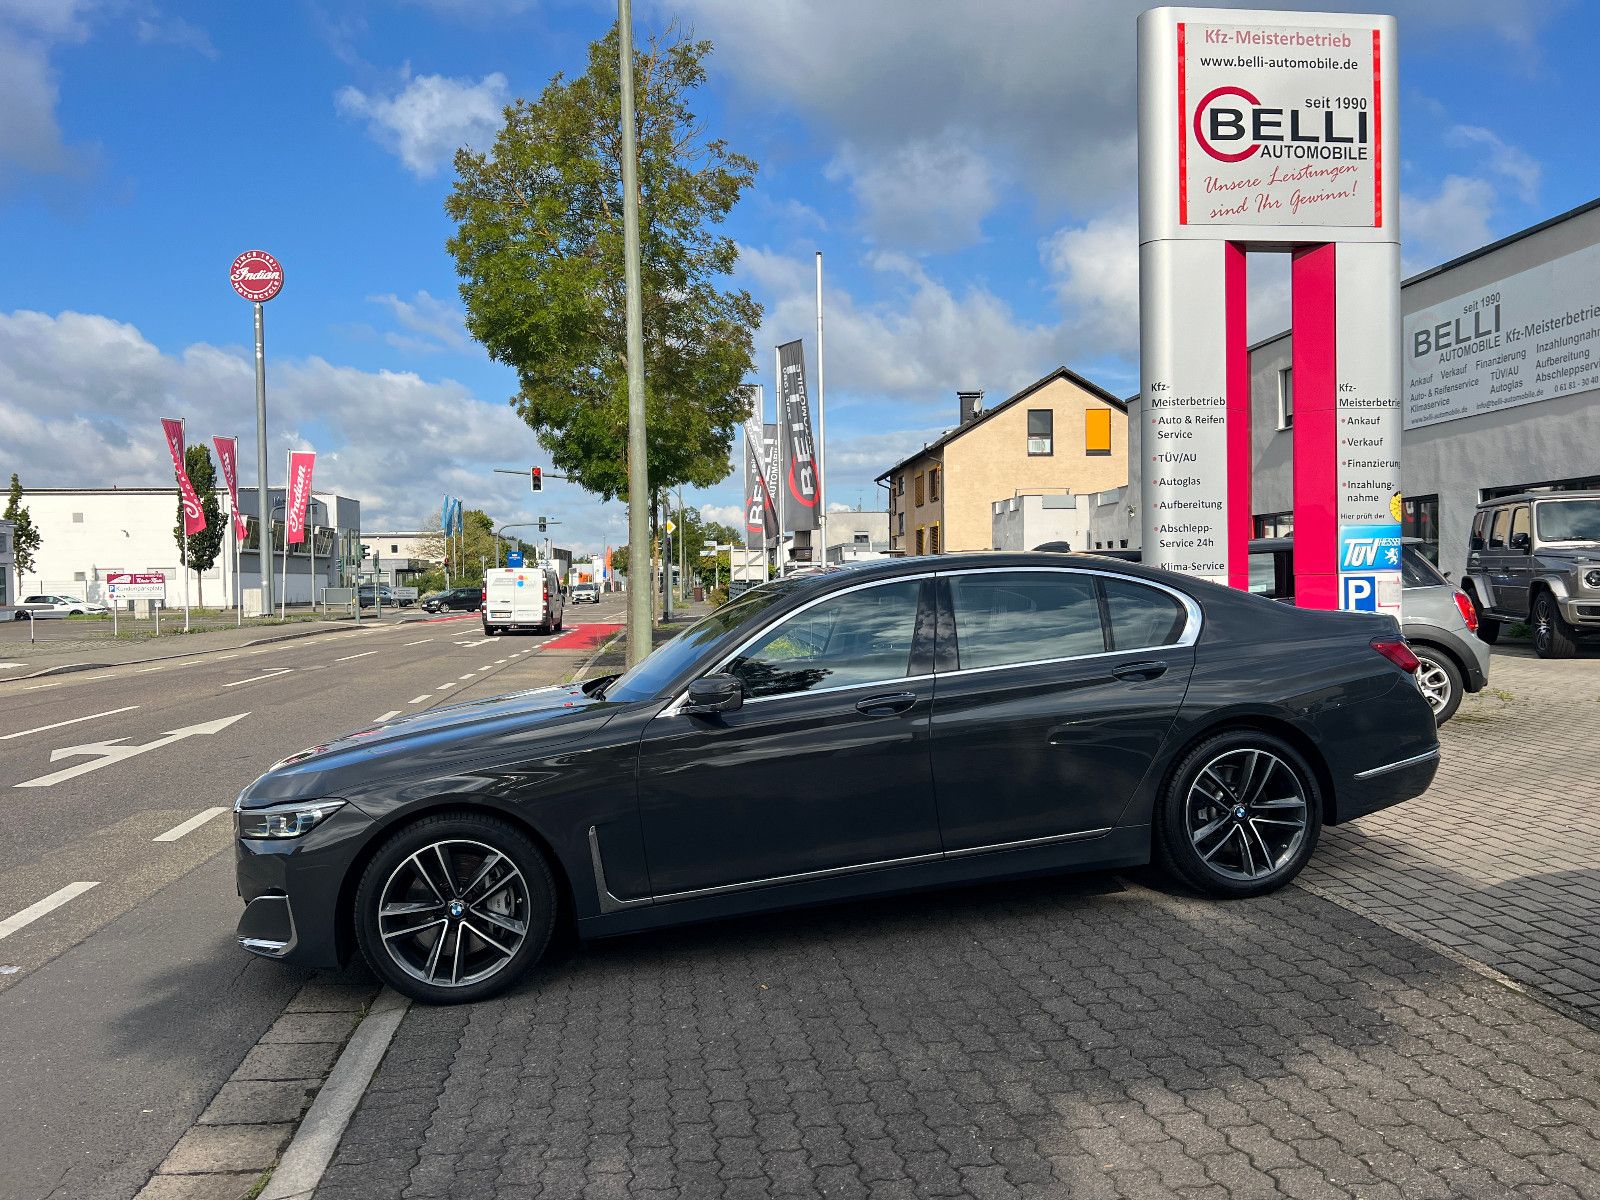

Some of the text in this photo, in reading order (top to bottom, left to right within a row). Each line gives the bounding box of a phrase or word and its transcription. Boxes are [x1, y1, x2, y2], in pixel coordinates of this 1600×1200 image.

[1204, 29, 1352, 48] Kfz-Meisterbetrieb
[1200, 56, 1358, 70] www.belli-automobile.de
[1305, 97, 1367, 110] seit 1990
[1210, 108, 1367, 143] BELLI
[1260, 144, 1368, 161] AUTOMOBILE
[1204, 163, 1358, 194] Unsere Leistungen
[1210, 180, 1358, 218] sind Ihr Gewinn!
[231, 266, 281, 281] Indian
[1463, 292, 1500, 314] seit 1990
[1414, 303, 1500, 358] BELLI
[1439, 335, 1501, 364] AUTOMOBILE
[1535, 349, 1590, 370] Aufbereitung
[1410, 349, 1527, 388] Ankauf Verkauf Finanzierung
[1151, 382, 1170, 392] Kfz-
[1339, 383, 1357, 392] Kfz-
[1428, 388, 1433, 398] &
[1434, 378, 1479, 396] Reifenservice
[1489, 379, 1523, 394] Autoglas
[1151, 396, 1226, 408] Meisterbetrieb
[1410, 397, 1450, 413] Klimaservice
[1158, 415, 1225, 425] Auto & Reifen
[1347, 416, 1380, 425] Ankauf
[1157, 430, 1193, 439] Service
[1347, 437, 1383, 446] Verkauf
[1158, 452, 1197, 463] TÜV/AU
[1159, 477, 1201, 487] Autoglas
[1347, 480, 1395, 491] Inzahlung-
[1347, 493, 1379, 502] nahme
[1159, 500, 1222, 510] Aufbereitung
[1356, 513, 1373, 521] prüft
[1160, 524, 1213, 534] Abschlepp-
[1159, 538, 1214, 548] Service 24h
[1160, 562, 1225, 571] Klima-Service
